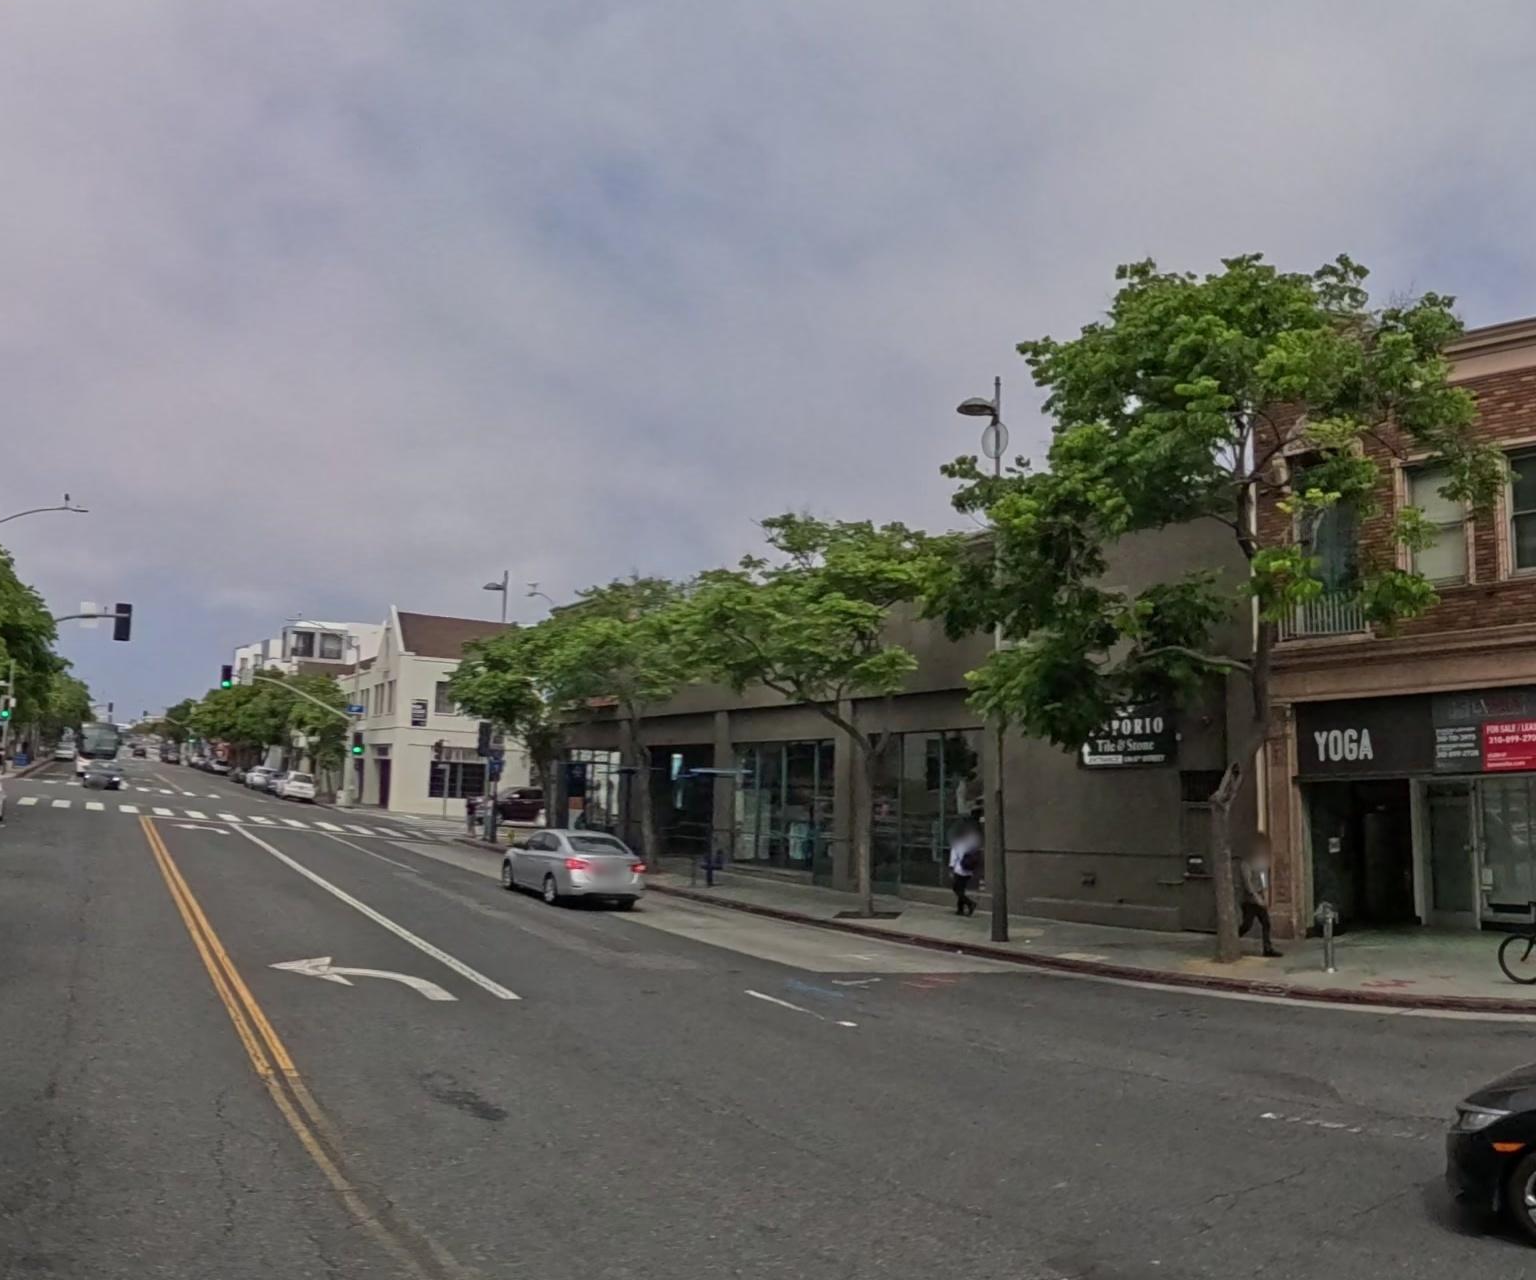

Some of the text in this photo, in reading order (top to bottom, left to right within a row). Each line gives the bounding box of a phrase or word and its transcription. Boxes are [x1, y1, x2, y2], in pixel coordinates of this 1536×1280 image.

[1486, 724, 1499, 734] FOR
[1500, 723, 1516, 733] SALE
[1096, 739, 1116, 752] Tile
[1126, 739, 1154, 752] Stone
[1314, 728, 1374, 762] YOGA
